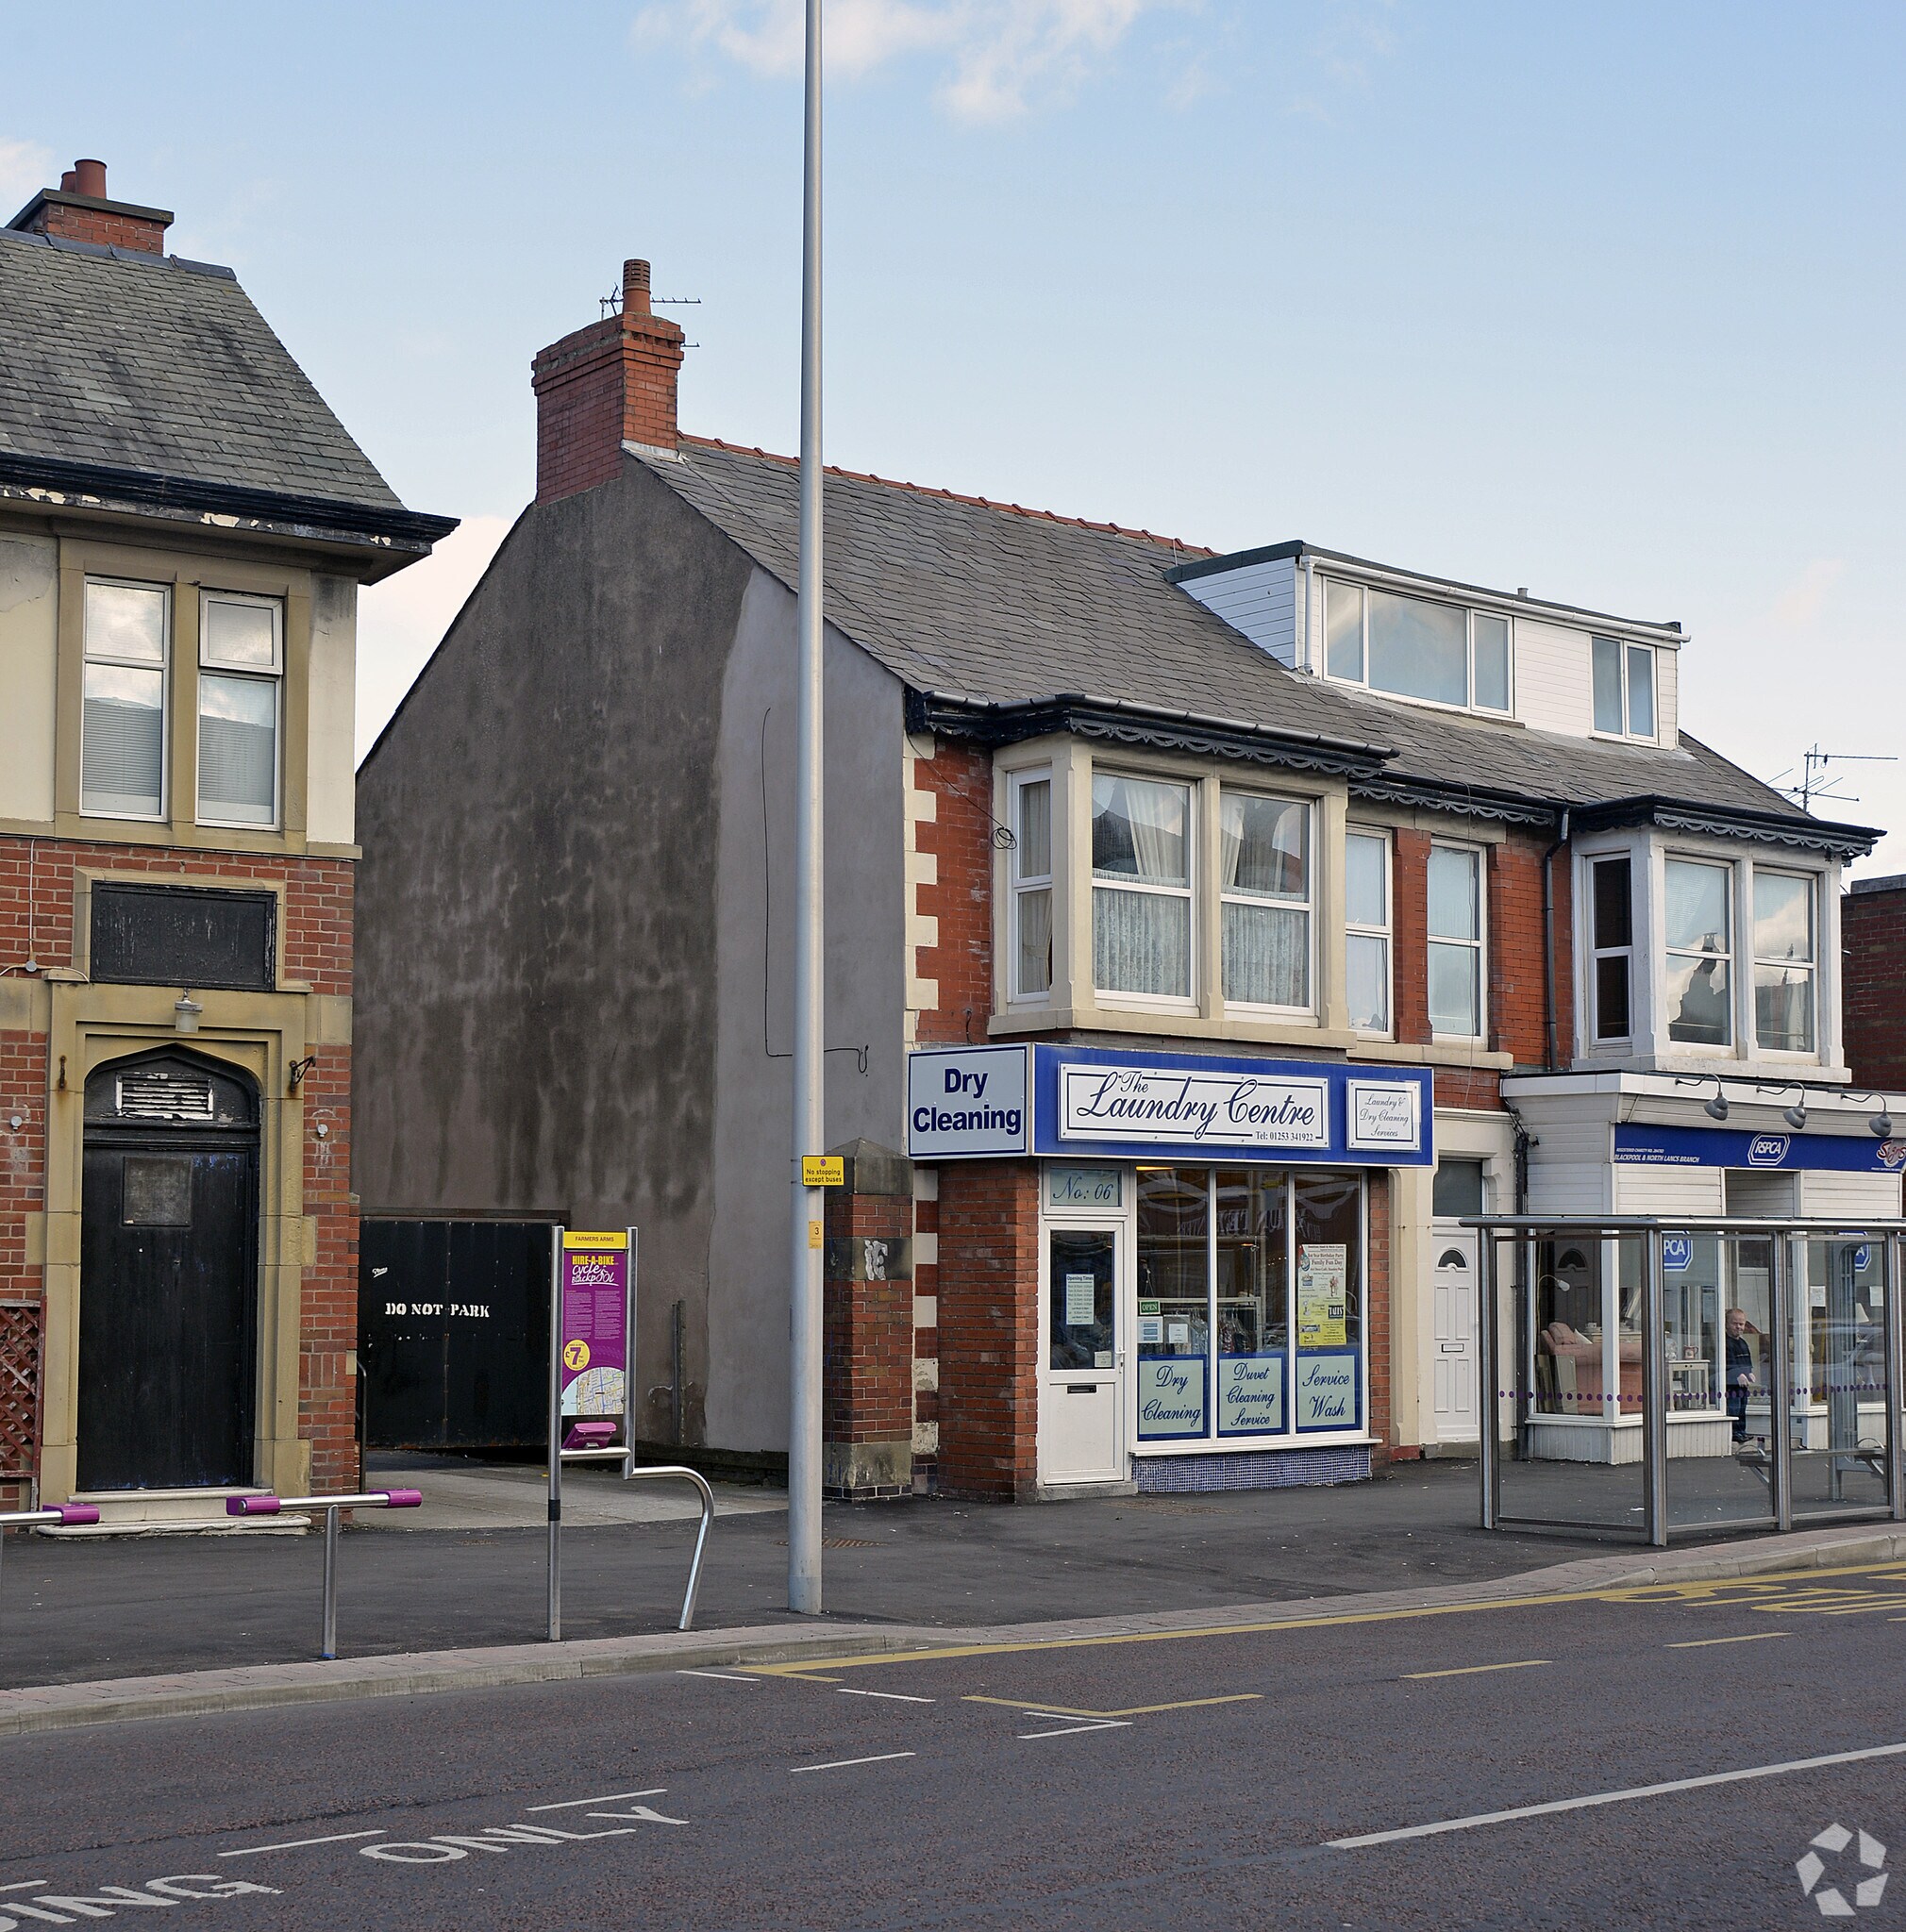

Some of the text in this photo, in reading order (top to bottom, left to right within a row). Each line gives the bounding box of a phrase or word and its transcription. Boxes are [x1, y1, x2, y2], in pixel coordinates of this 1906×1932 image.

[945, 1068, 989, 1099] Dry
[1119, 1071, 1148, 1092] The
[1077, 1072, 1315, 1141] Laundry Centre
[1364, 1093, 1406, 1110] Laundry &
[913, 1105, 1021, 1136] Cleaning
[1360, 1108, 1409, 1126] Dry Cleaning
[1255, 1131, 1313, 1141] Tel: 01253 341922
[1370, 1124, 1398, 1137] Services
[1755, 1141, 1781, 1154] RSPCA
[1052, 1175, 1114, 1200] No: 06
[385, 1303, 490, 1318] DO NOT PARK
[1156, 1365, 1188, 1394] Dry
[1233, 1362, 1270, 1381] Duvet
[1302, 1364, 1350, 1387] Service
[1227, 1385, 1276, 1408] Cleaning
[1309, 1395, 1346, 1419] Wash
[1141, 1398, 1201, 1426] Cleaning
[1230, 1407, 1270, 1426] Service
[359, 1806, 691, 1863] ONLY
[0, 1874, 284, 1932] ING
